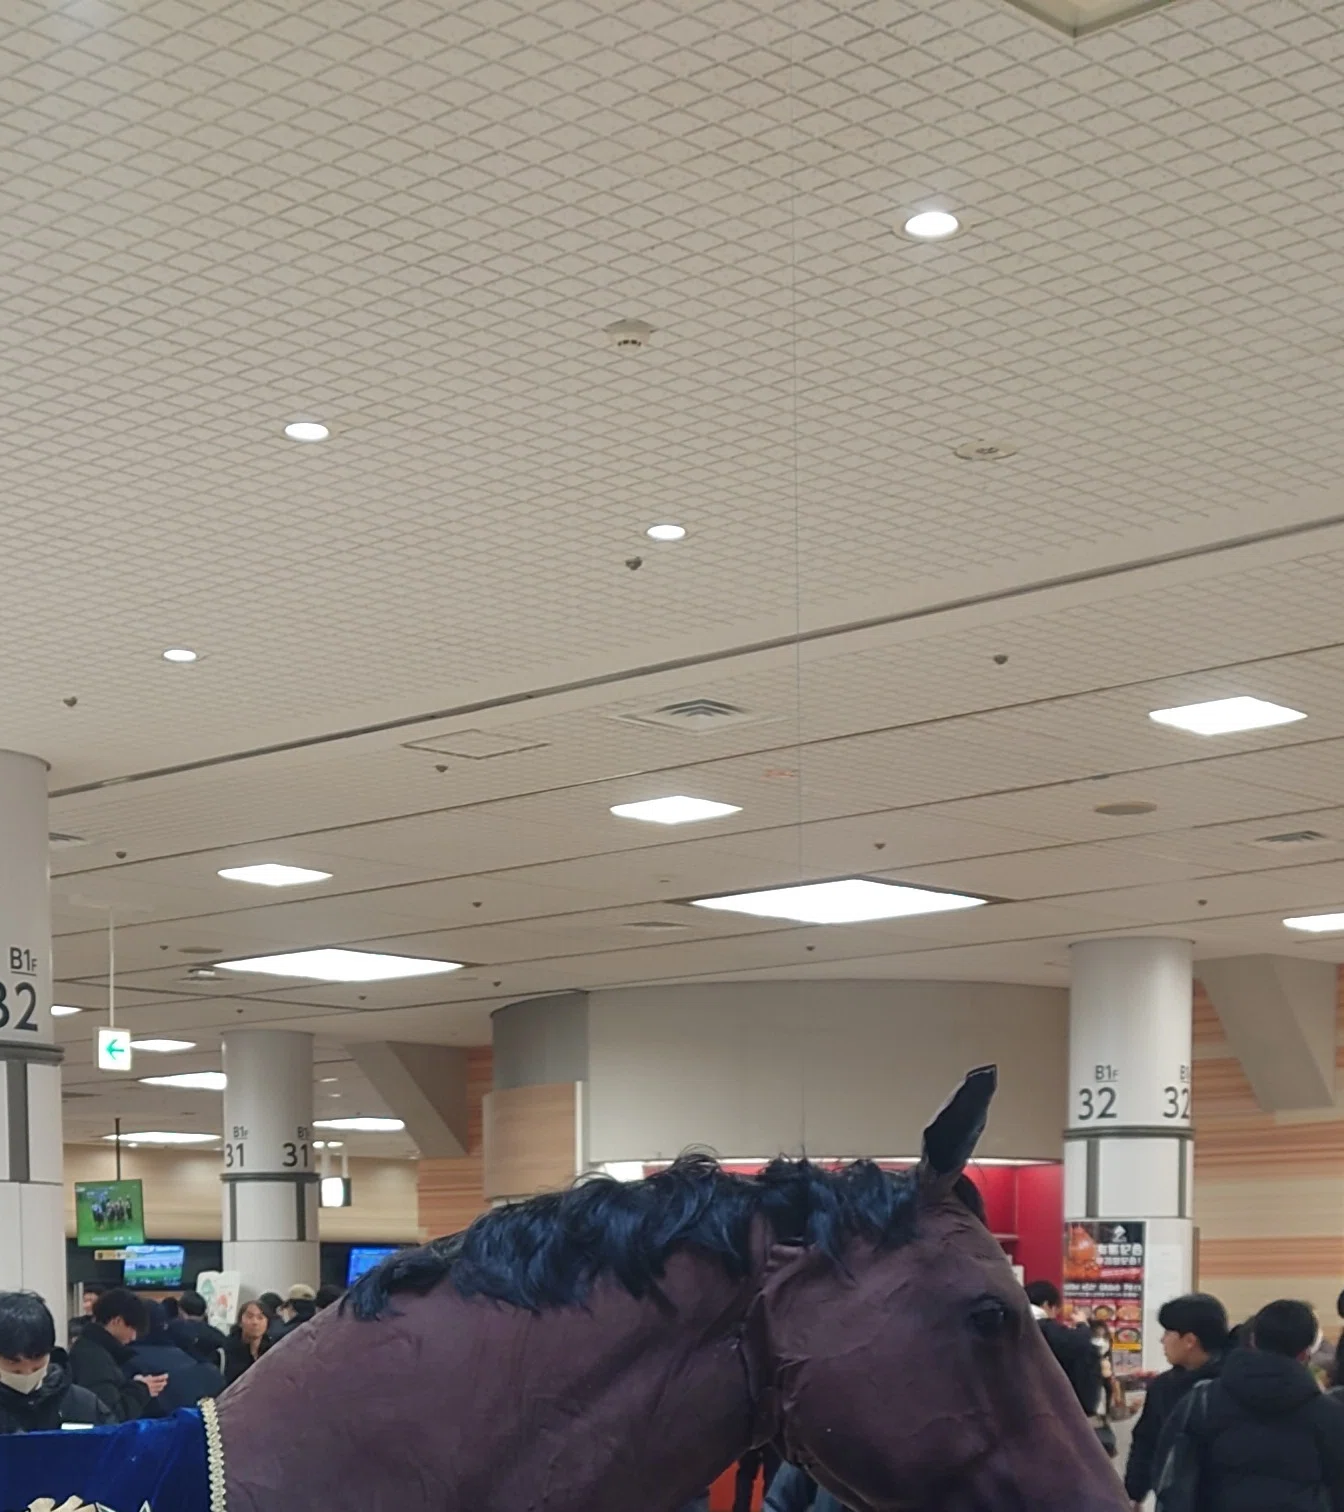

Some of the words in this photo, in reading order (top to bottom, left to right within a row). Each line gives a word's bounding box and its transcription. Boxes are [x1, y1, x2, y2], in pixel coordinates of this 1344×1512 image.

[10, 947, 38, 972] B1F
[1095, 1065, 1118, 1080] B1F
[1078, 1087, 1118, 1120] 32
[226, 1143, 244, 1167] 31
[282, 1142, 308, 1167] 31
